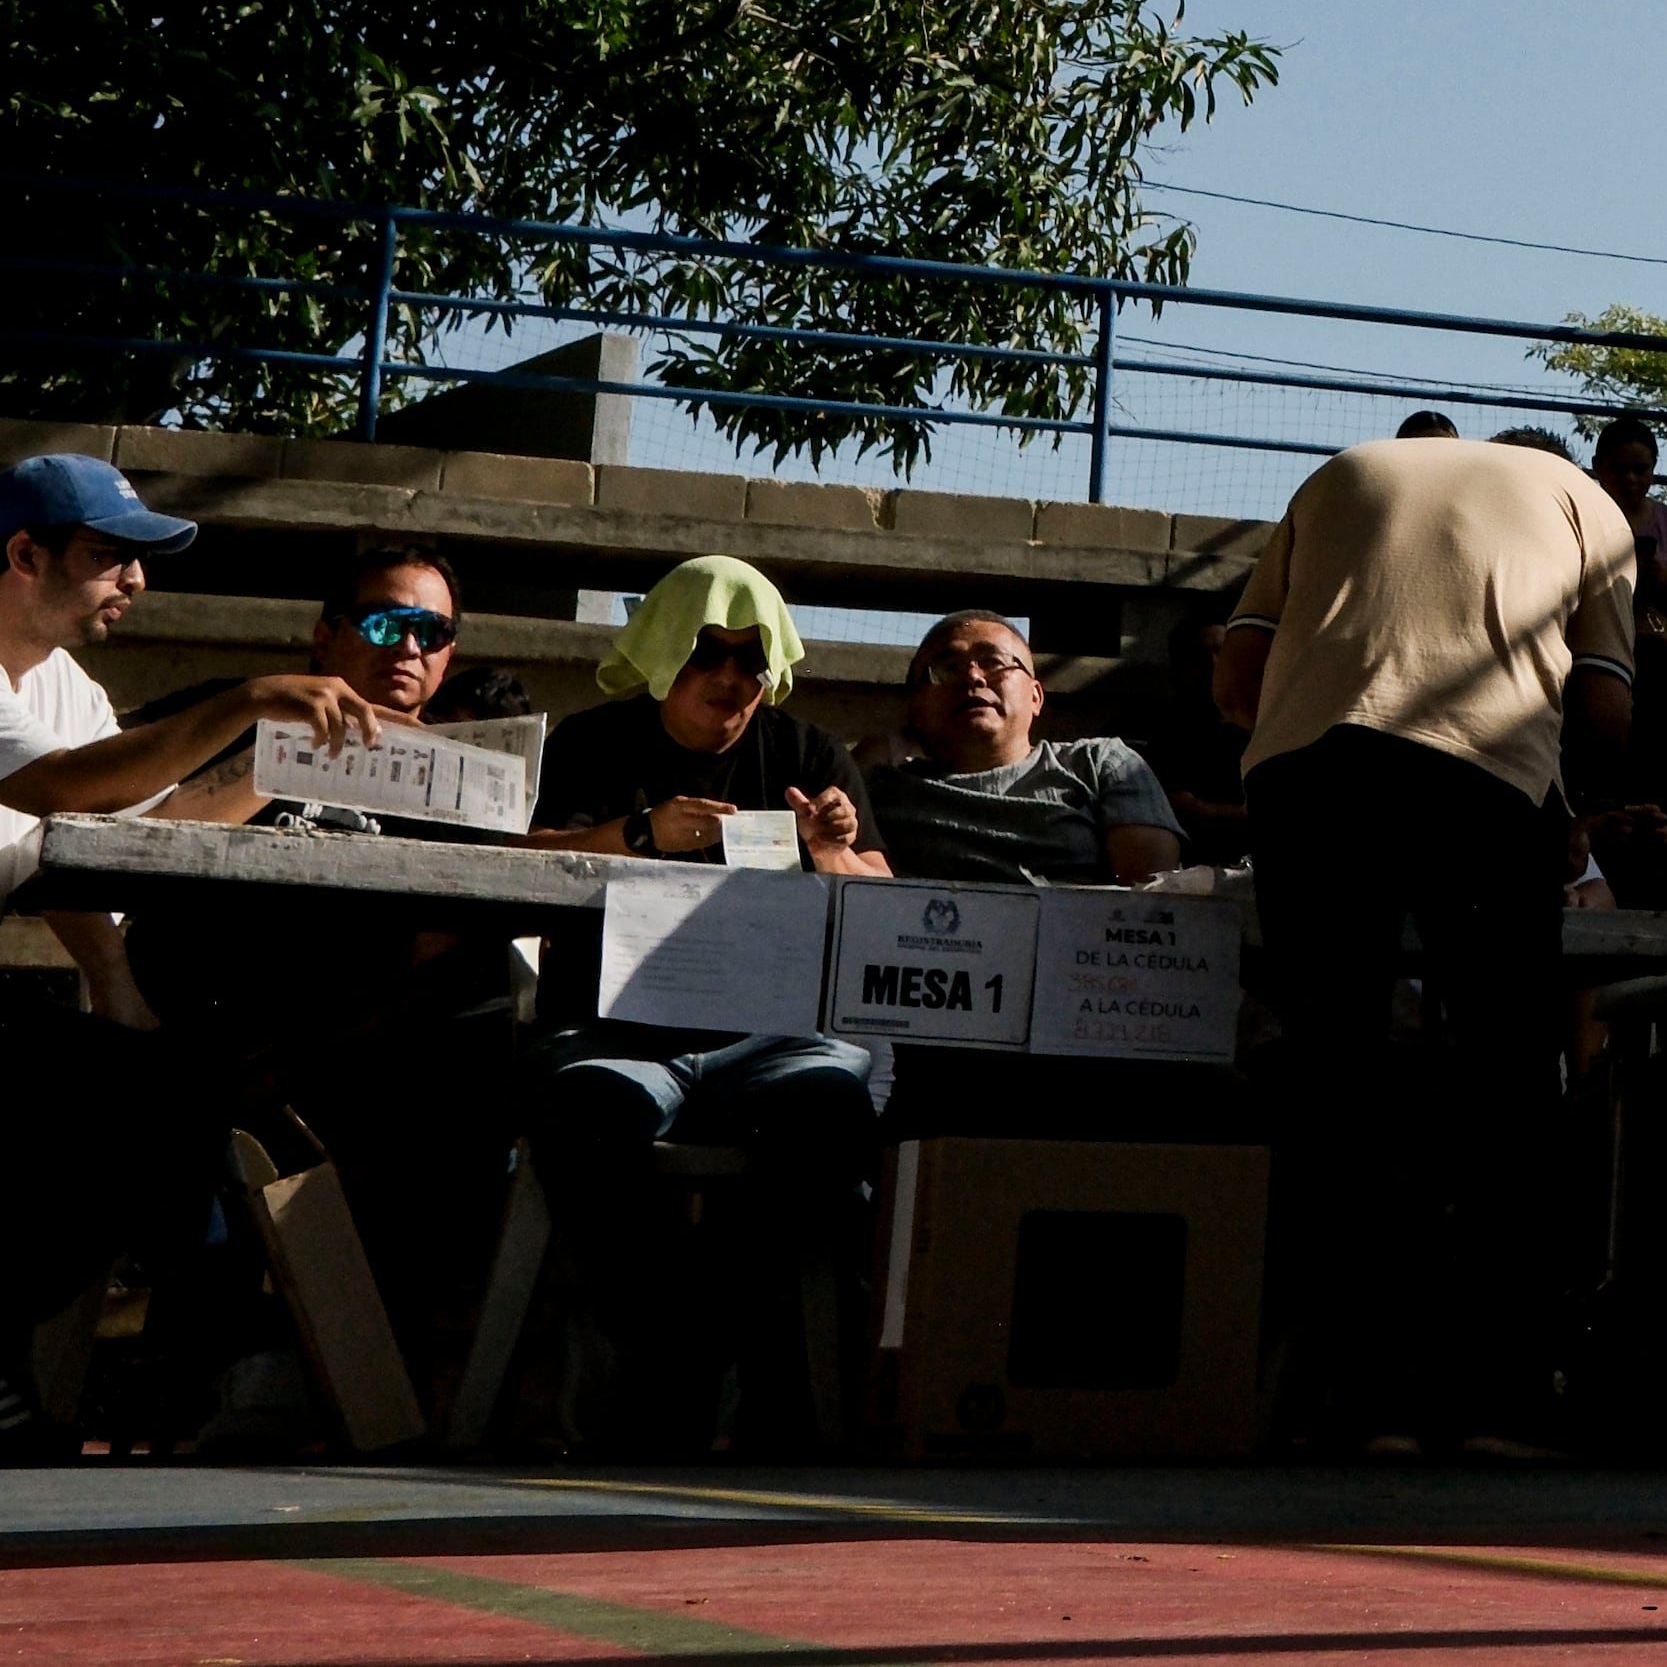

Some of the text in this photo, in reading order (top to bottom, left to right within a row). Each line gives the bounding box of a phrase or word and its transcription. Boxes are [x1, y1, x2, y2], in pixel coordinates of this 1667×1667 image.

[1105, 928, 1176, 946] MESA 1
[1076, 950, 1101, 966] DE
[1107, 953, 1130, 967] LA
[861, 964, 1004, 1014] MESA 1
[1079, 998, 1093, 1012] A
[1098, 998, 1121, 1014] LA
